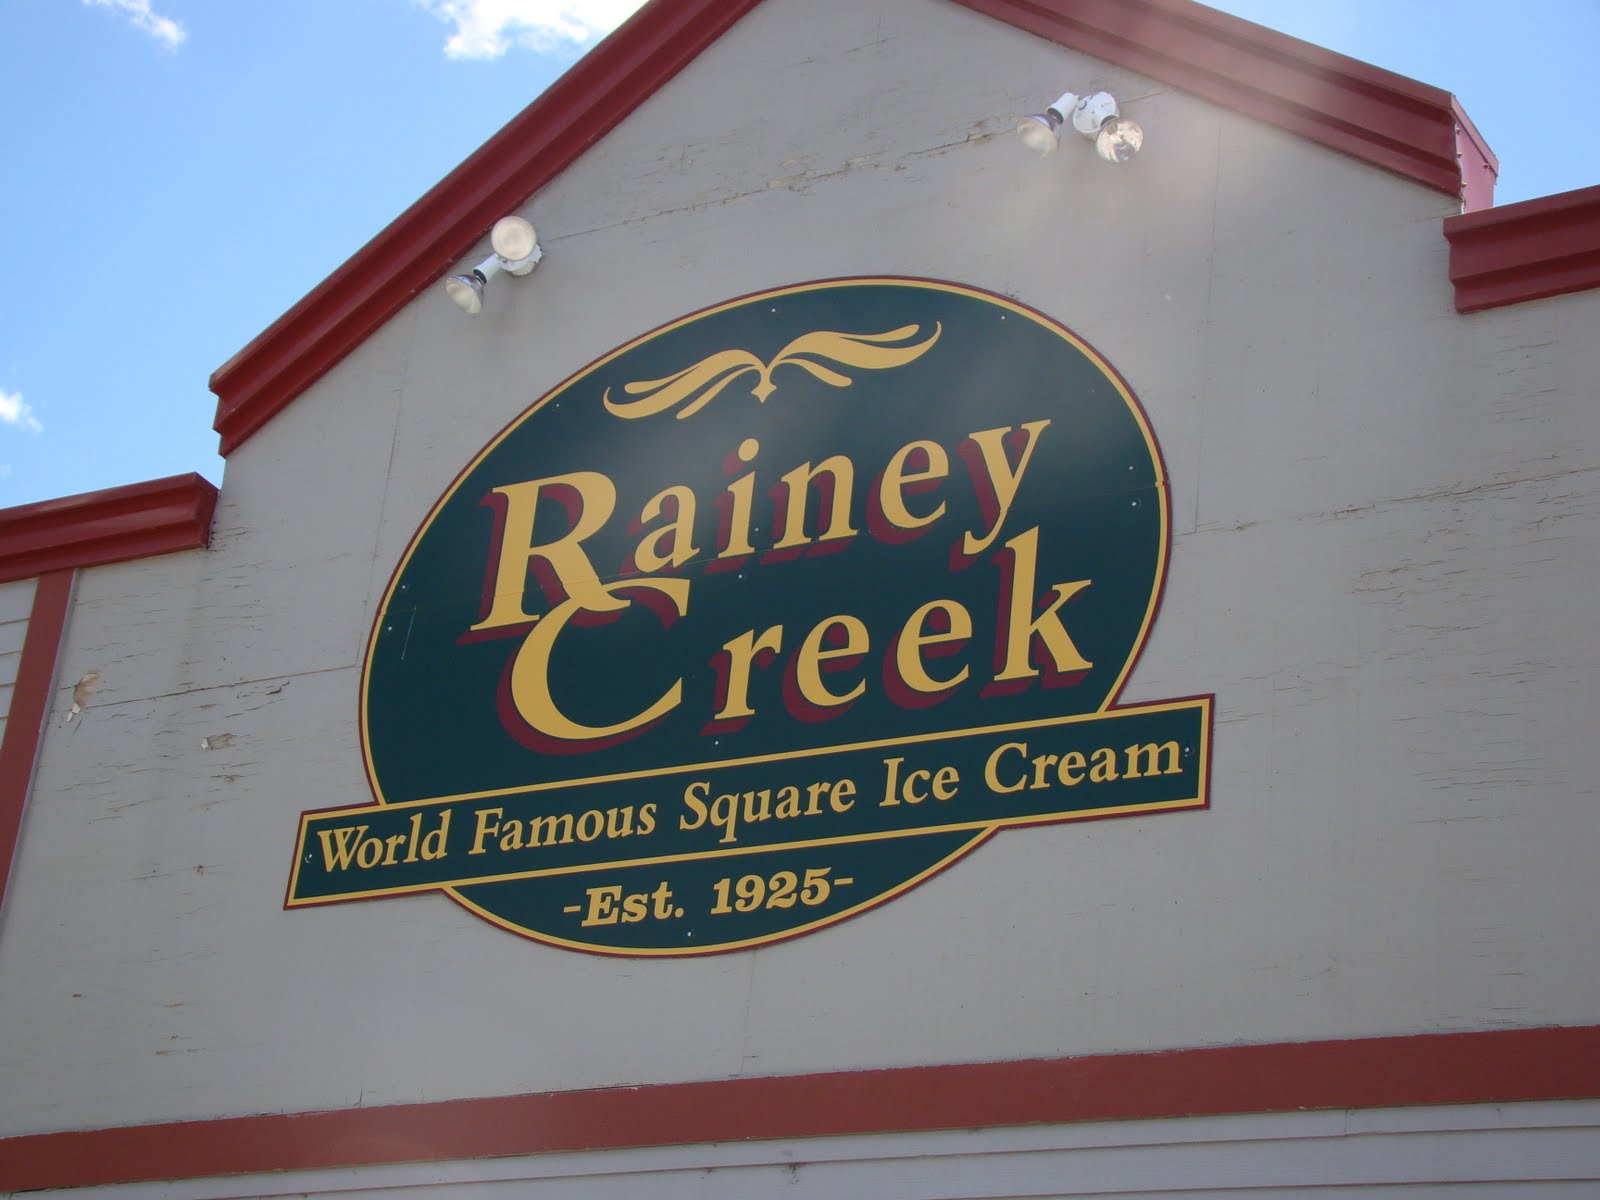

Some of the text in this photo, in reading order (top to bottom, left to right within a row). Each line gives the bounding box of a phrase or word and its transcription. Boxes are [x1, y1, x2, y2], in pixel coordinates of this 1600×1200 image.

[471, 419, 1051, 631] Rainey
[511, 527, 1093, 740] Creek
[317, 740, 1183, 872] World Famous Square Ice Cream
[563, 867, 854, 928] -Est. 1925-
